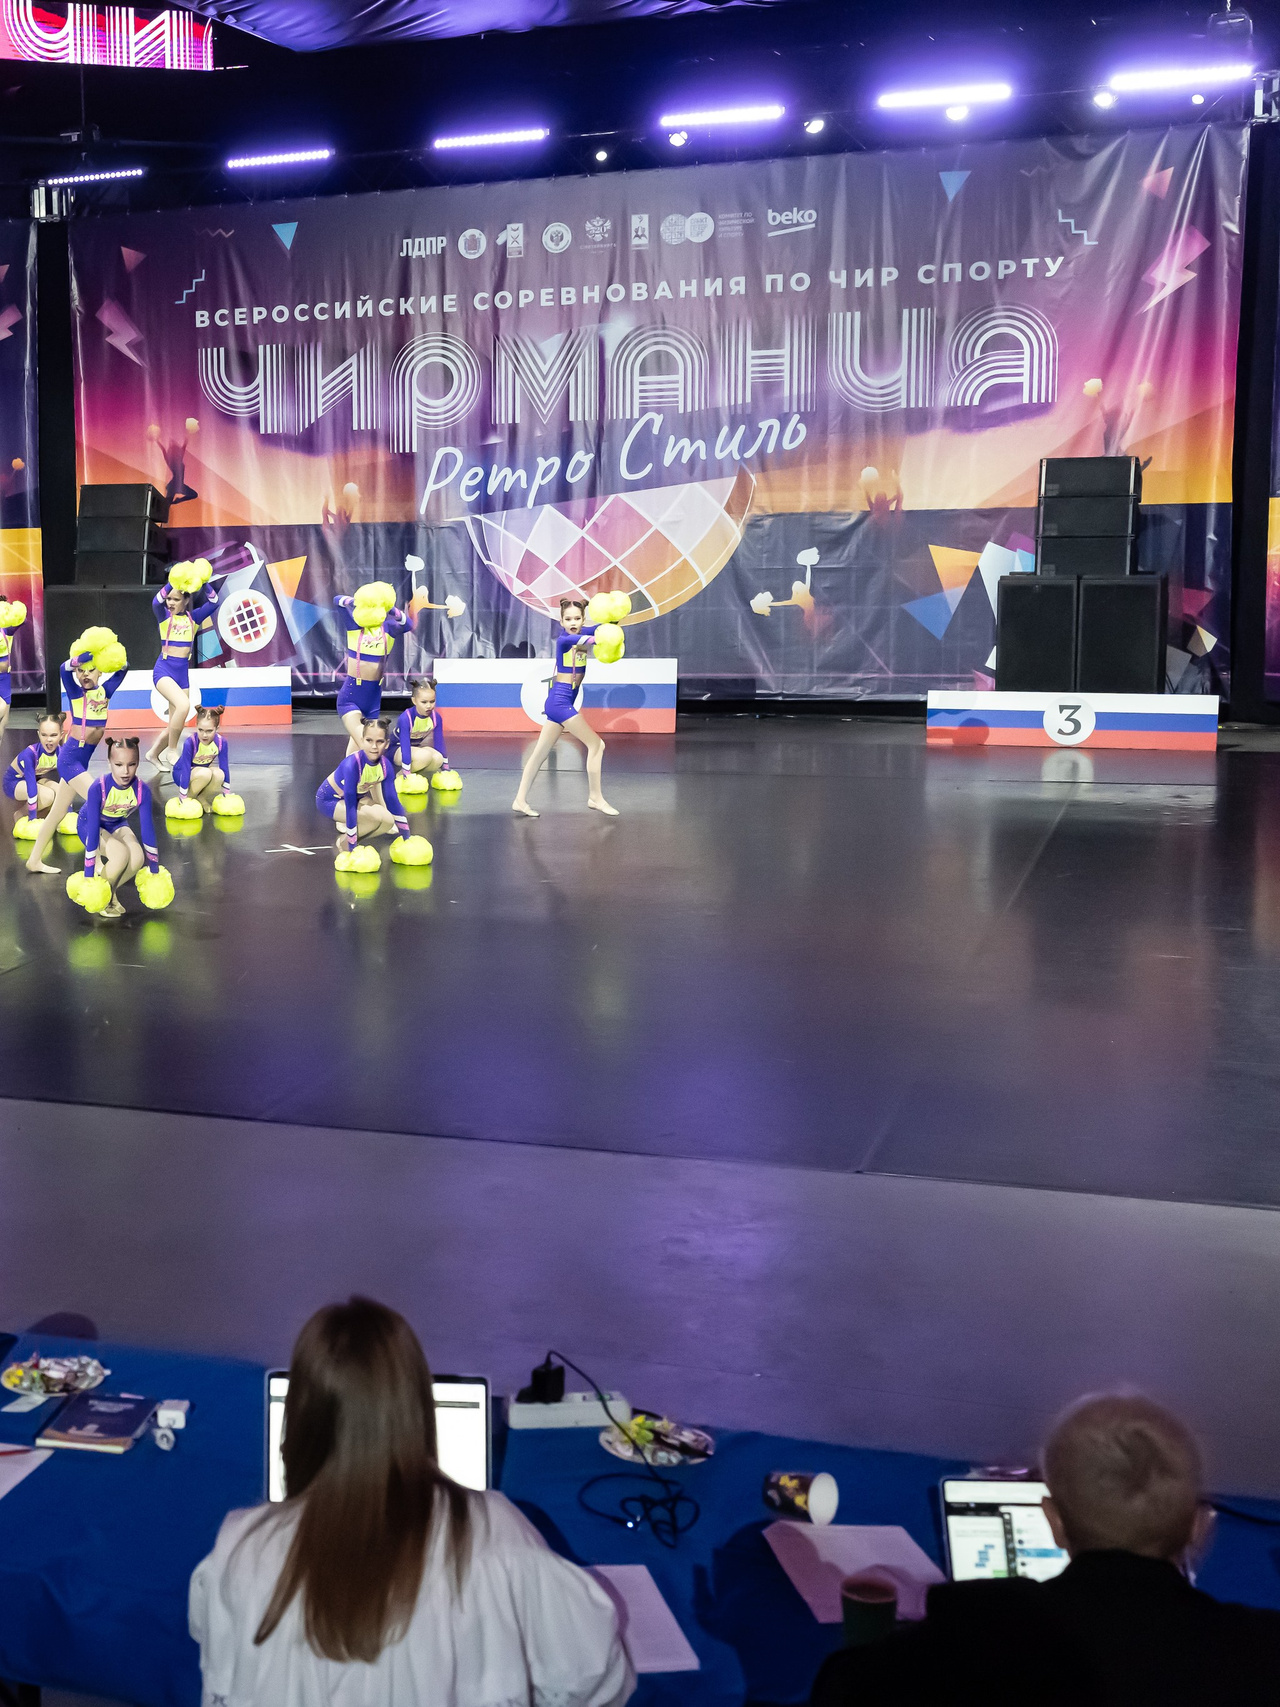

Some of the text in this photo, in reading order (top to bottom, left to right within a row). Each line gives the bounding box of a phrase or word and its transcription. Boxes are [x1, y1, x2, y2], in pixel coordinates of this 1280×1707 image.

[767, 207, 818, 226] beko
[400, 236, 447, 258] ЛДПР
[195, 256, 1066, 328] ВСЕРОССИЙСКИЕ СОРЕВНОВАНИЯ ПО ЧИР СПОРТУ
[419, 412, 808, 515] Ретро Стиль
[1056, 704, 1082, 736] 3
